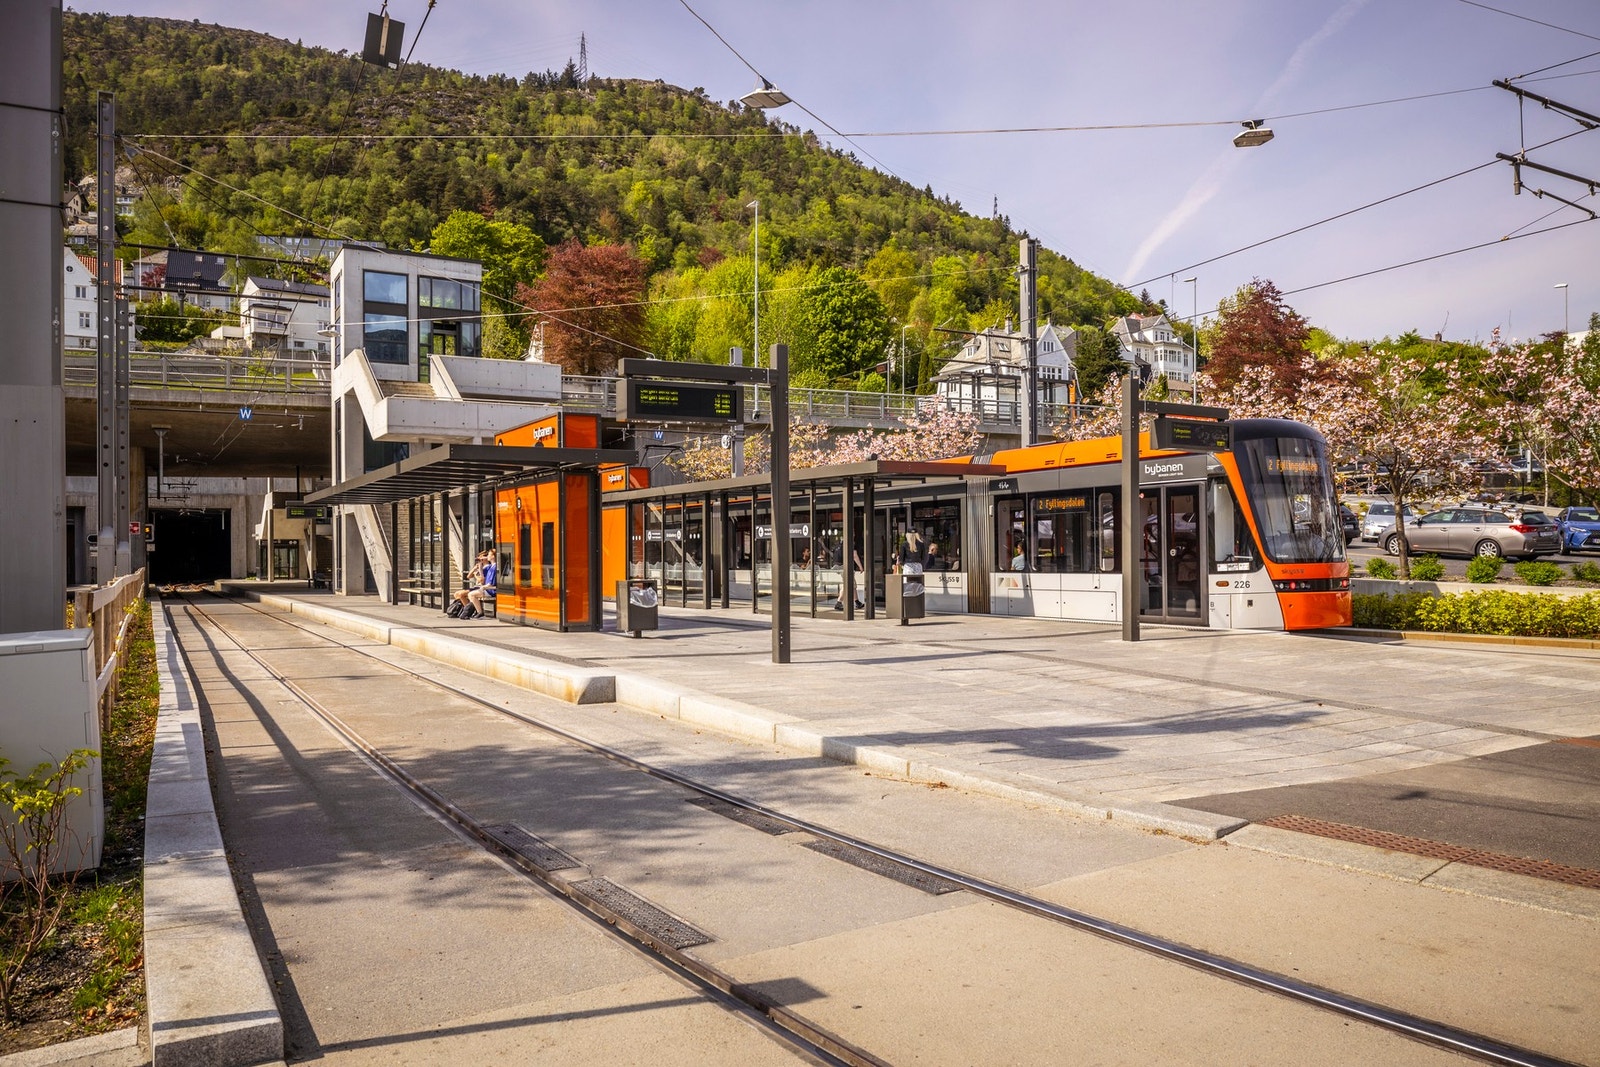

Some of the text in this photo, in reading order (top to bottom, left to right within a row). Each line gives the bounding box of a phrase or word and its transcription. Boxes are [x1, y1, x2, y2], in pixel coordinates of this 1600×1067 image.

[240, 409, 252, 419] W
[533, 426, 552, 440] bybanen
[655, 431, 663, 439] W
[1144, 463, 1183, 475] bybanen
[1039, 497, 1085, 510] 2 Fyllingsdalen
[1234, 580, 1251, 589] 226
